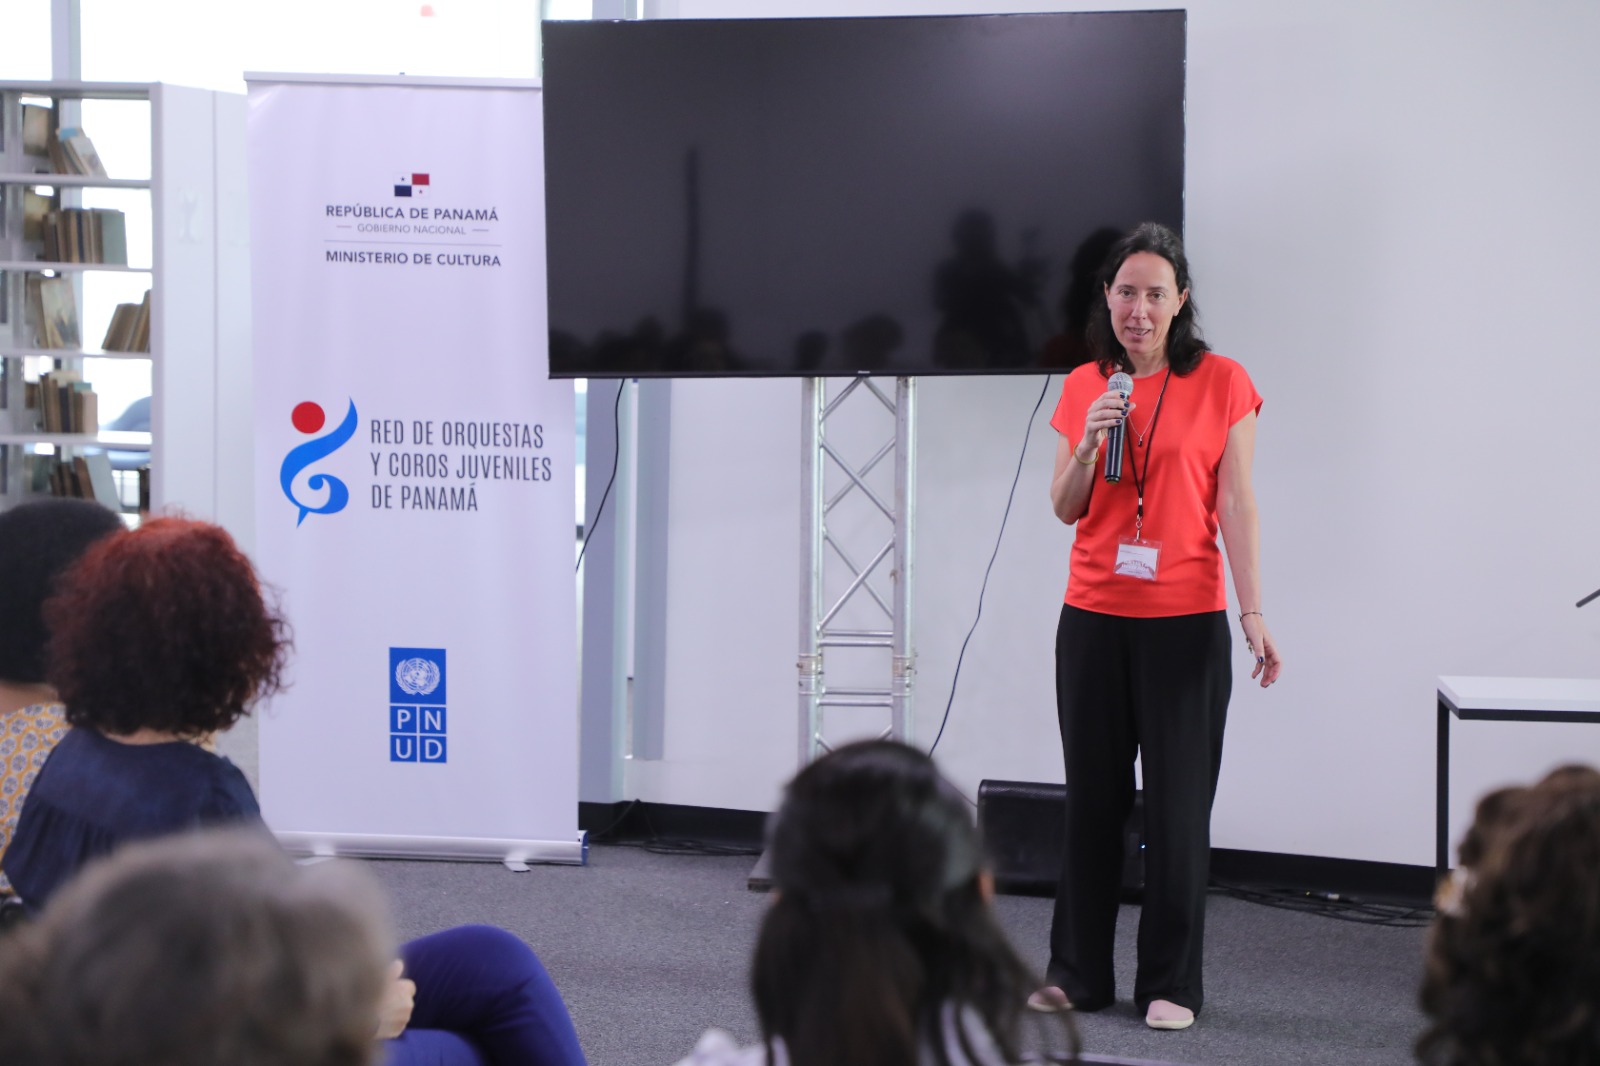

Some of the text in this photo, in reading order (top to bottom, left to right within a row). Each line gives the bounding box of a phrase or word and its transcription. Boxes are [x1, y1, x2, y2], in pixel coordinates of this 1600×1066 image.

[325, 202, 499, 221] REPÚBLICA DE PANAMÁ
[356, 223, 467, 236] GOBIERNO NACIONAL
[325, 250, 502, 267] MINISTERIO DE CULTURA
[370, 419, 544, 449] RED DE ORQUESTAS
[370, 452, 552, 482] Y COROS JUVENILES
[371, 482, 479, 512] DE PANAMÁ
